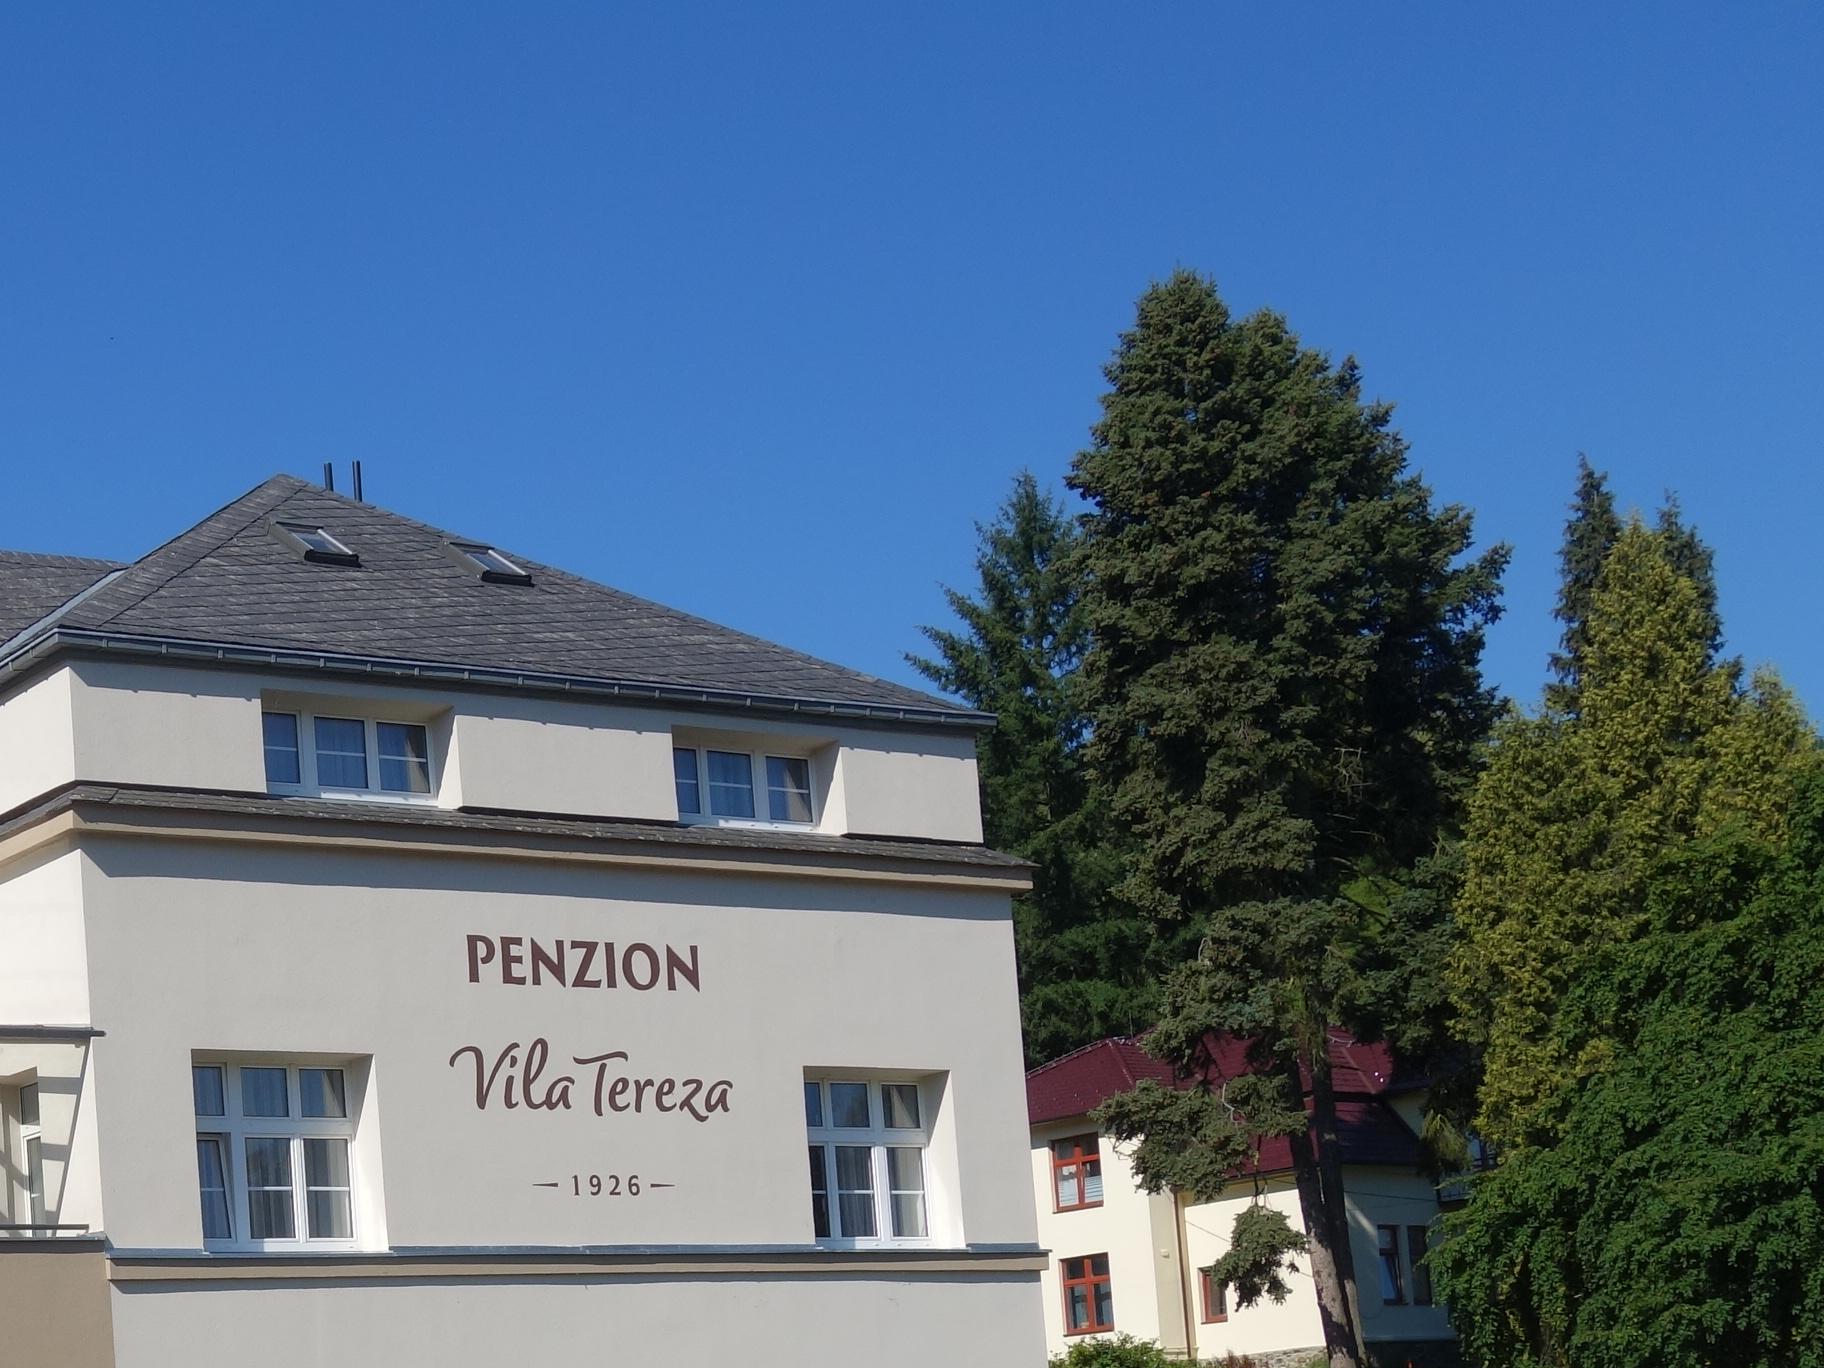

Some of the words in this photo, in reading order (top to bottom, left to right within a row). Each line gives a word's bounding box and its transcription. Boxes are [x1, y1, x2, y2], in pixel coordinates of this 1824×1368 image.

[466, 934, 701, 993] PENZION
[448, 1037, 575, 1110] Vila
[572, 1050, 734, 1123] Tereza
[572, 1174, 642, 1197] 1926
